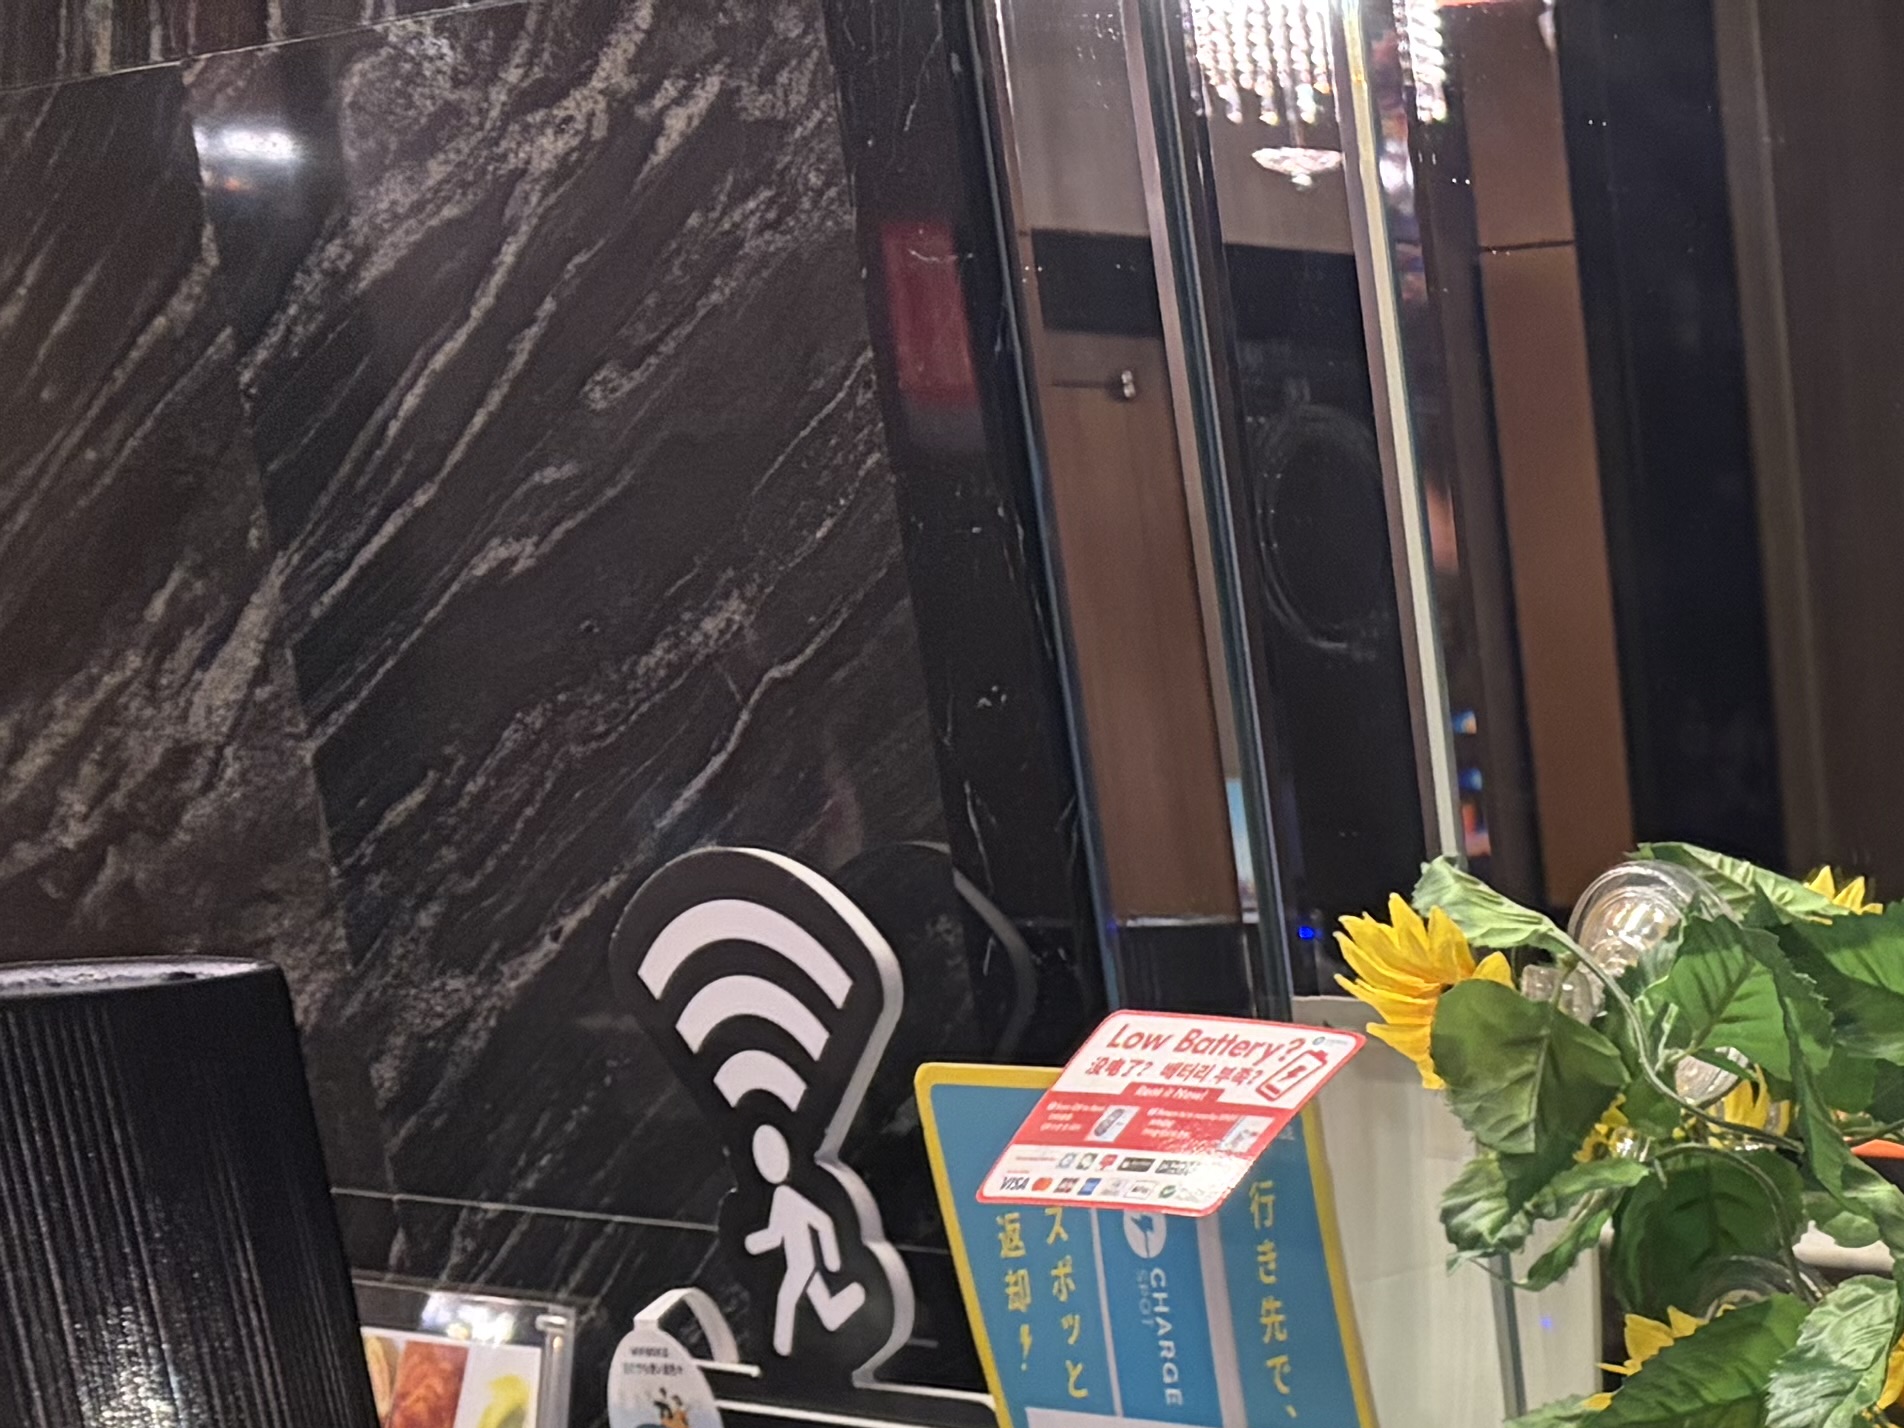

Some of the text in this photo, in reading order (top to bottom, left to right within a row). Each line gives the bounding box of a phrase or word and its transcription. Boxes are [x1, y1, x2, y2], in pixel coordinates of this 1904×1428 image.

[1107, 1023, 1303, 1062] Low Battery?
[1000, 1176, 1028, 1191] VISA
[996, 1213, 1033, 1372] 返却!
[1148, 1268, 1184, 1407] CHARGE
[1249, 1180, 1298, 1418] 行き先で、
